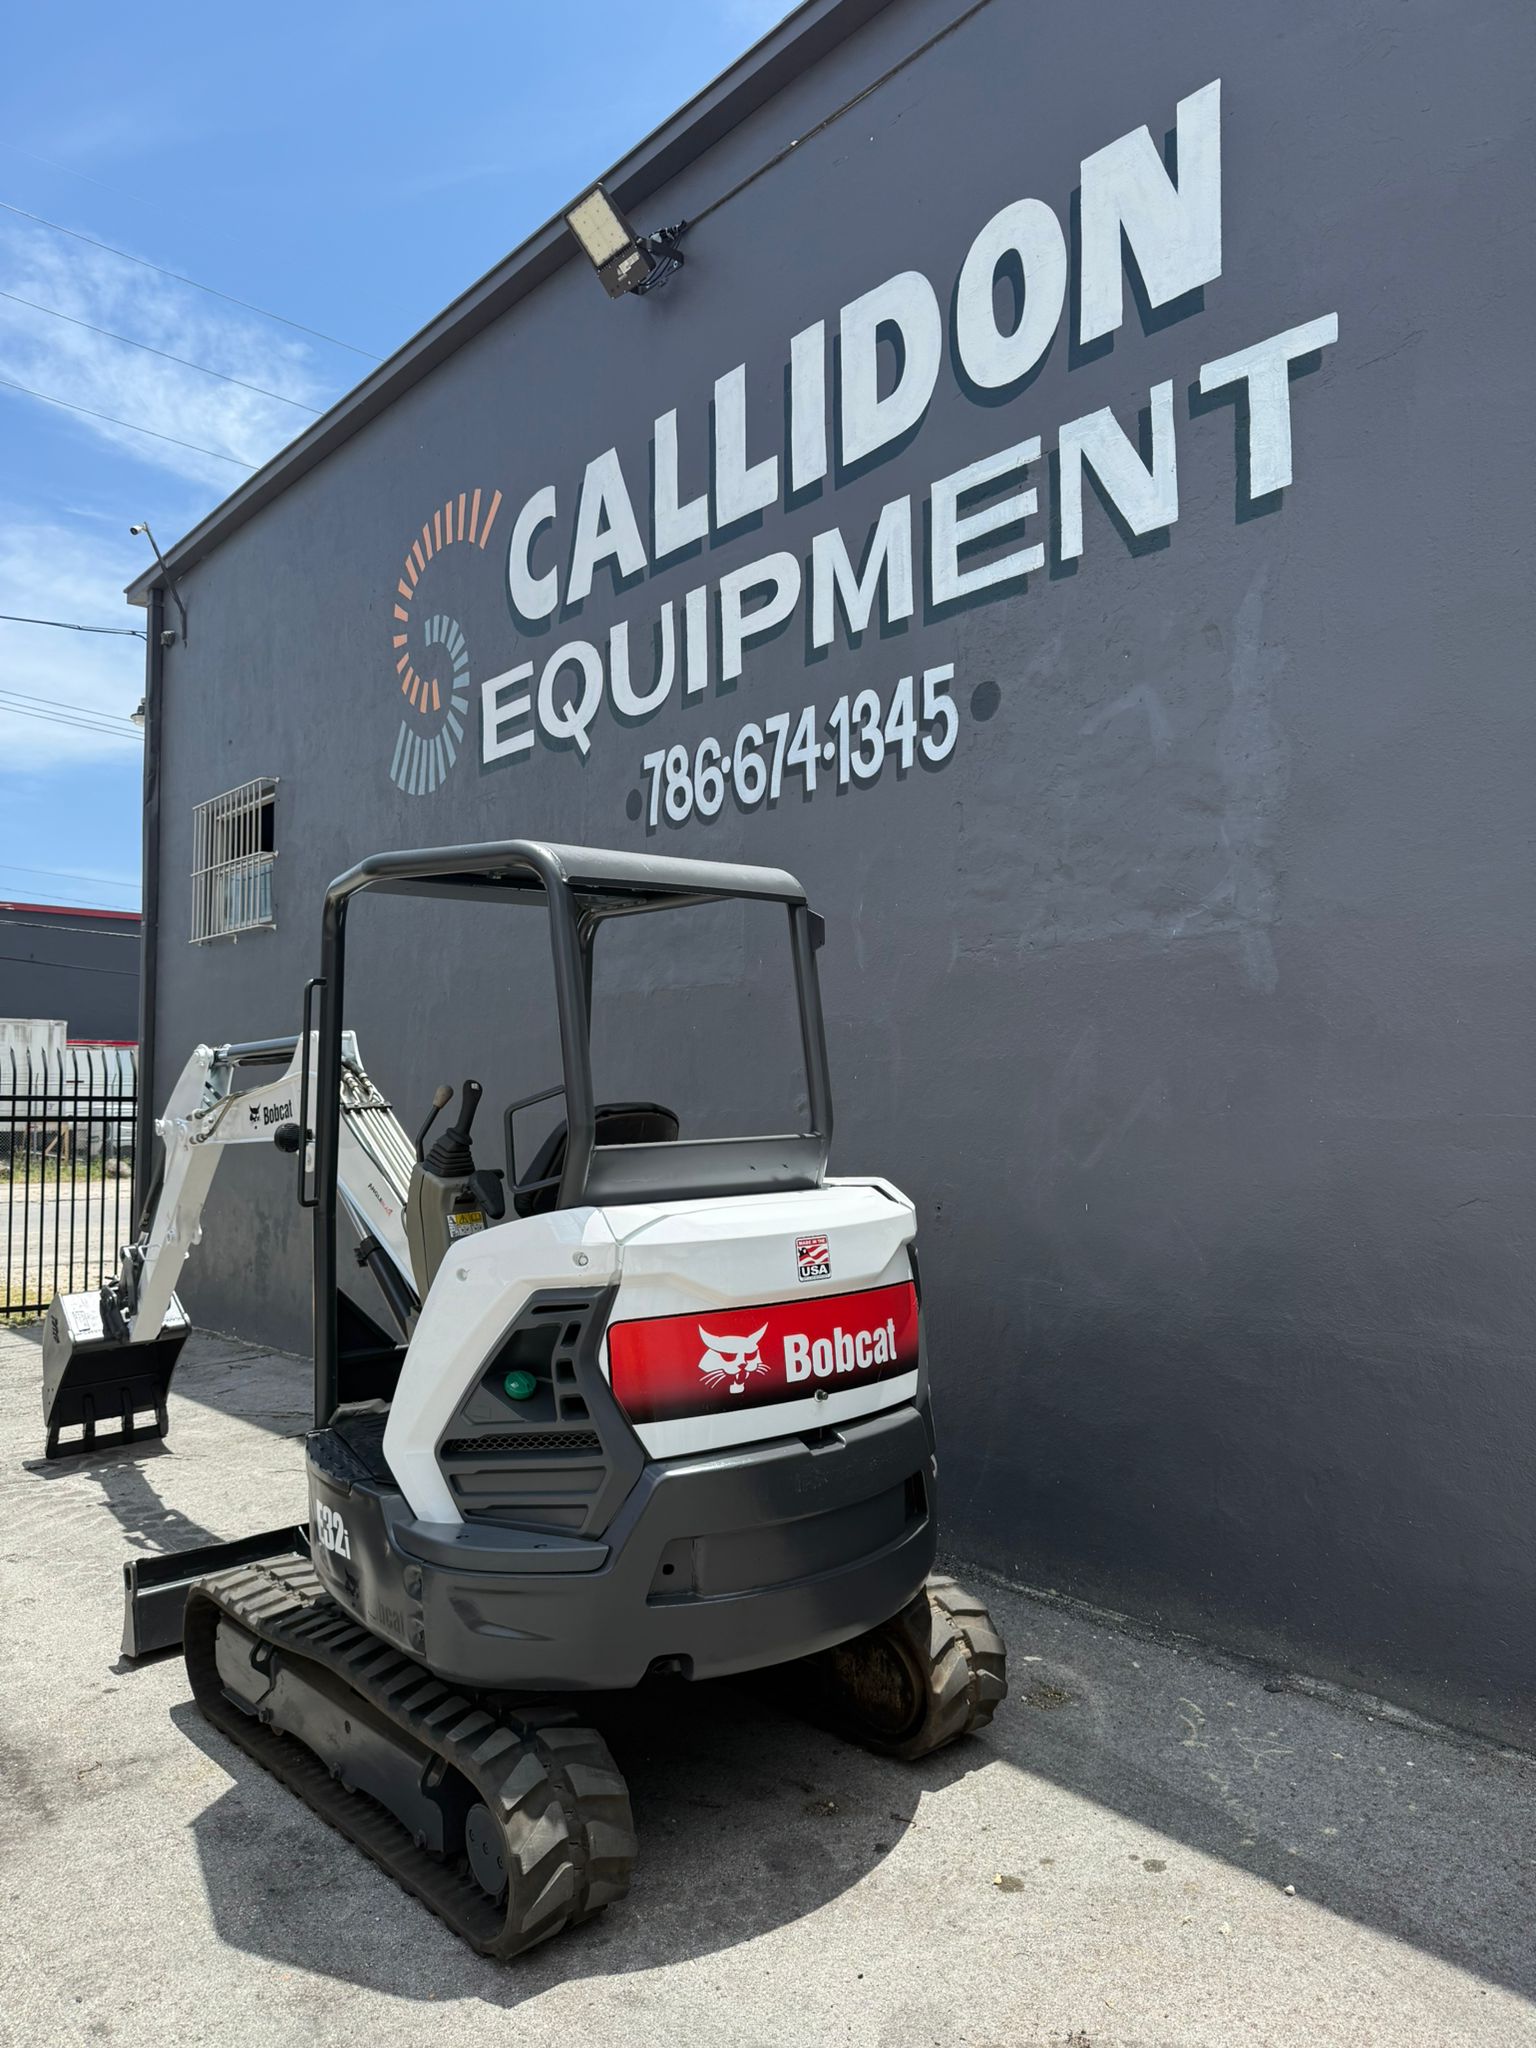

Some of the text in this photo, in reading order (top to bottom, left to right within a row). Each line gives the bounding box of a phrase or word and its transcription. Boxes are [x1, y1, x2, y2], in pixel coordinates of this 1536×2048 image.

[507, 78, 1223, 621] CALLIDON
[481, 312, 1339, 764] EQUIPMENT
[263, 1099, 293, 1126] Bobcat
[801, 1264, 828, 1276] USA
[783, 1317, 898, 1383] Bobcat
[316, 1498, 351, 1560] E32i
